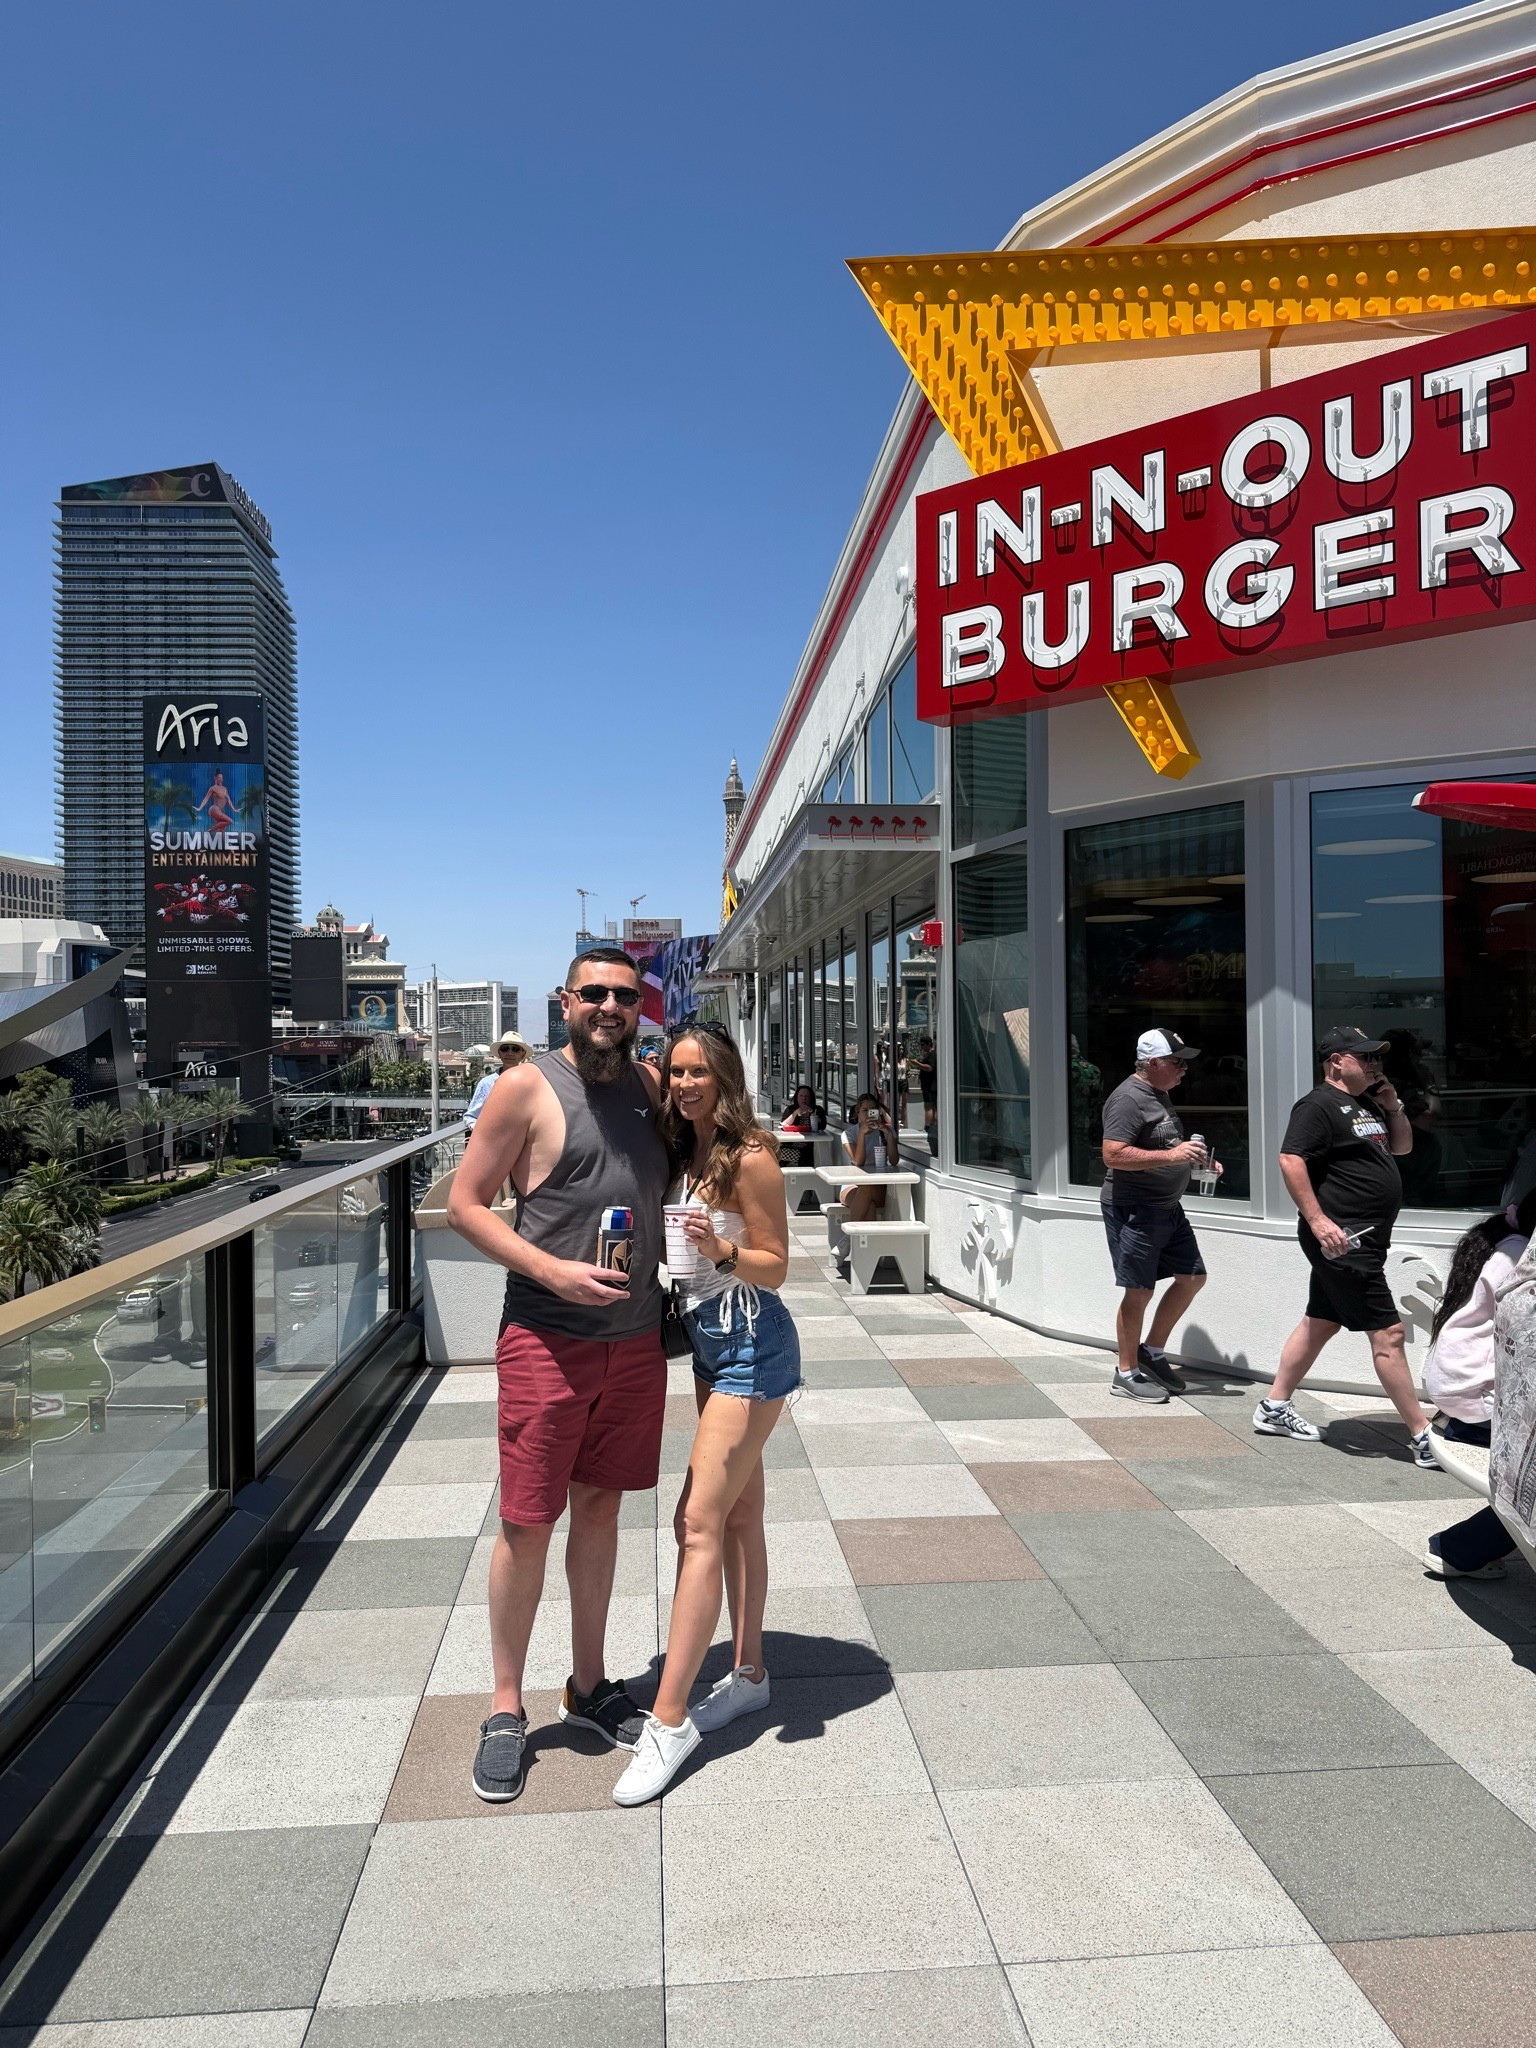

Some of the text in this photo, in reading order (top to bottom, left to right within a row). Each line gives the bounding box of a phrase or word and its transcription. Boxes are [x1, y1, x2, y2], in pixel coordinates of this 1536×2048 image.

[938, 344, 1529, 588] IN-N-OUT
[941, 485, 1524, 689] BURGER
[156, 703, 248, 751] Aria
[150, 831, 257, 851] SUMMER
[152, 852, 258, 867] ENTERTAINMENT
[632, 920, 660, 929] planet
[632, 931, 673, 940] hollywood
[185, 1061, 217, 1078] Aria
